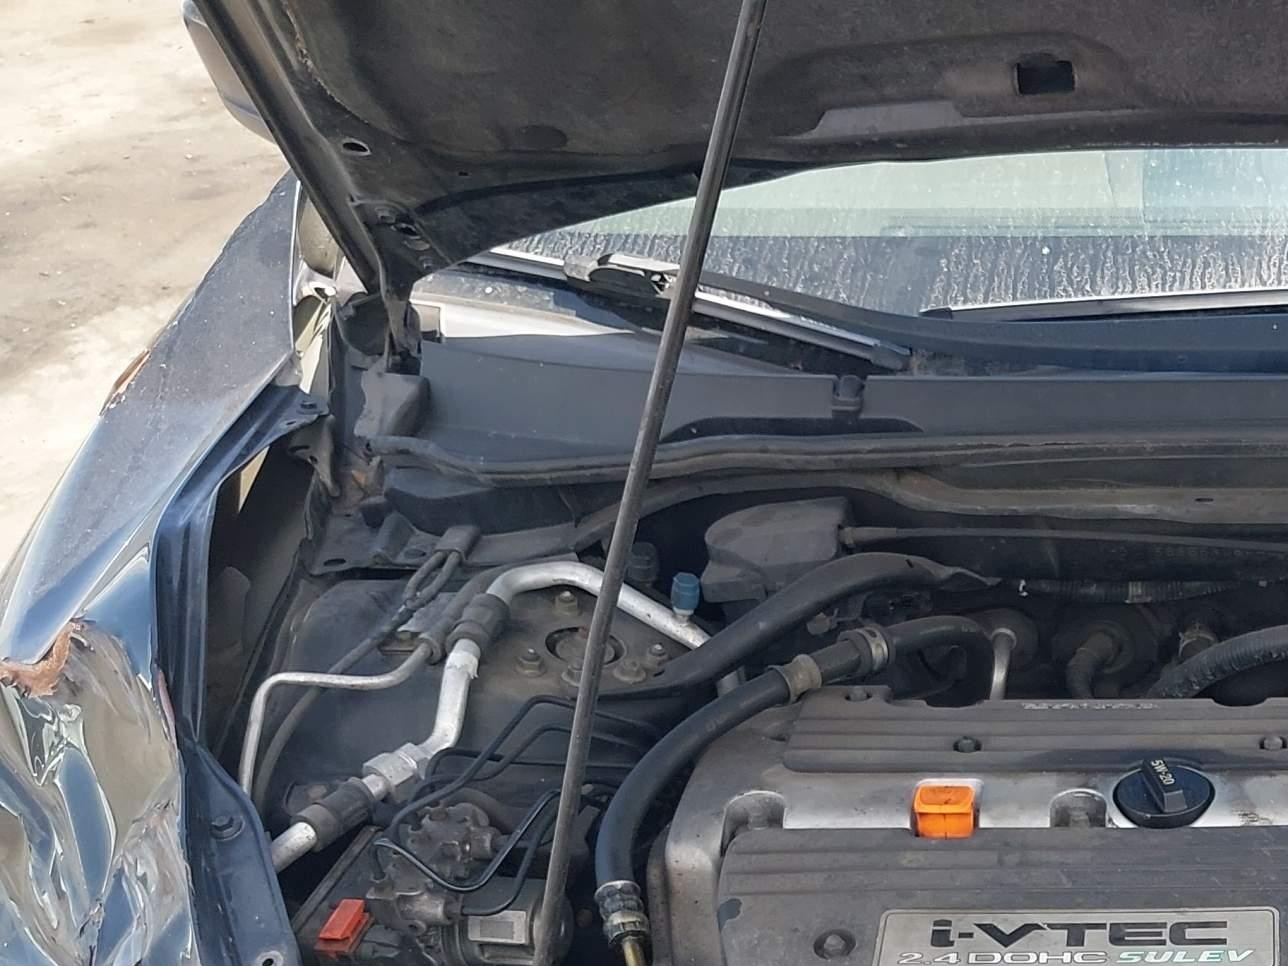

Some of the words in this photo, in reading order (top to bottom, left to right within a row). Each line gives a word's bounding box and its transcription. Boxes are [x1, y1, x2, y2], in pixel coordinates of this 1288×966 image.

[1151, 759, 1175, 785] 5W-20
[930, 919, 1228, 948] i-VTEC
[897, 951, 961, 966] 2.4
[967, 951, 1107, 966] DOHC
[1116, 949, 1255, 964] SULEV
